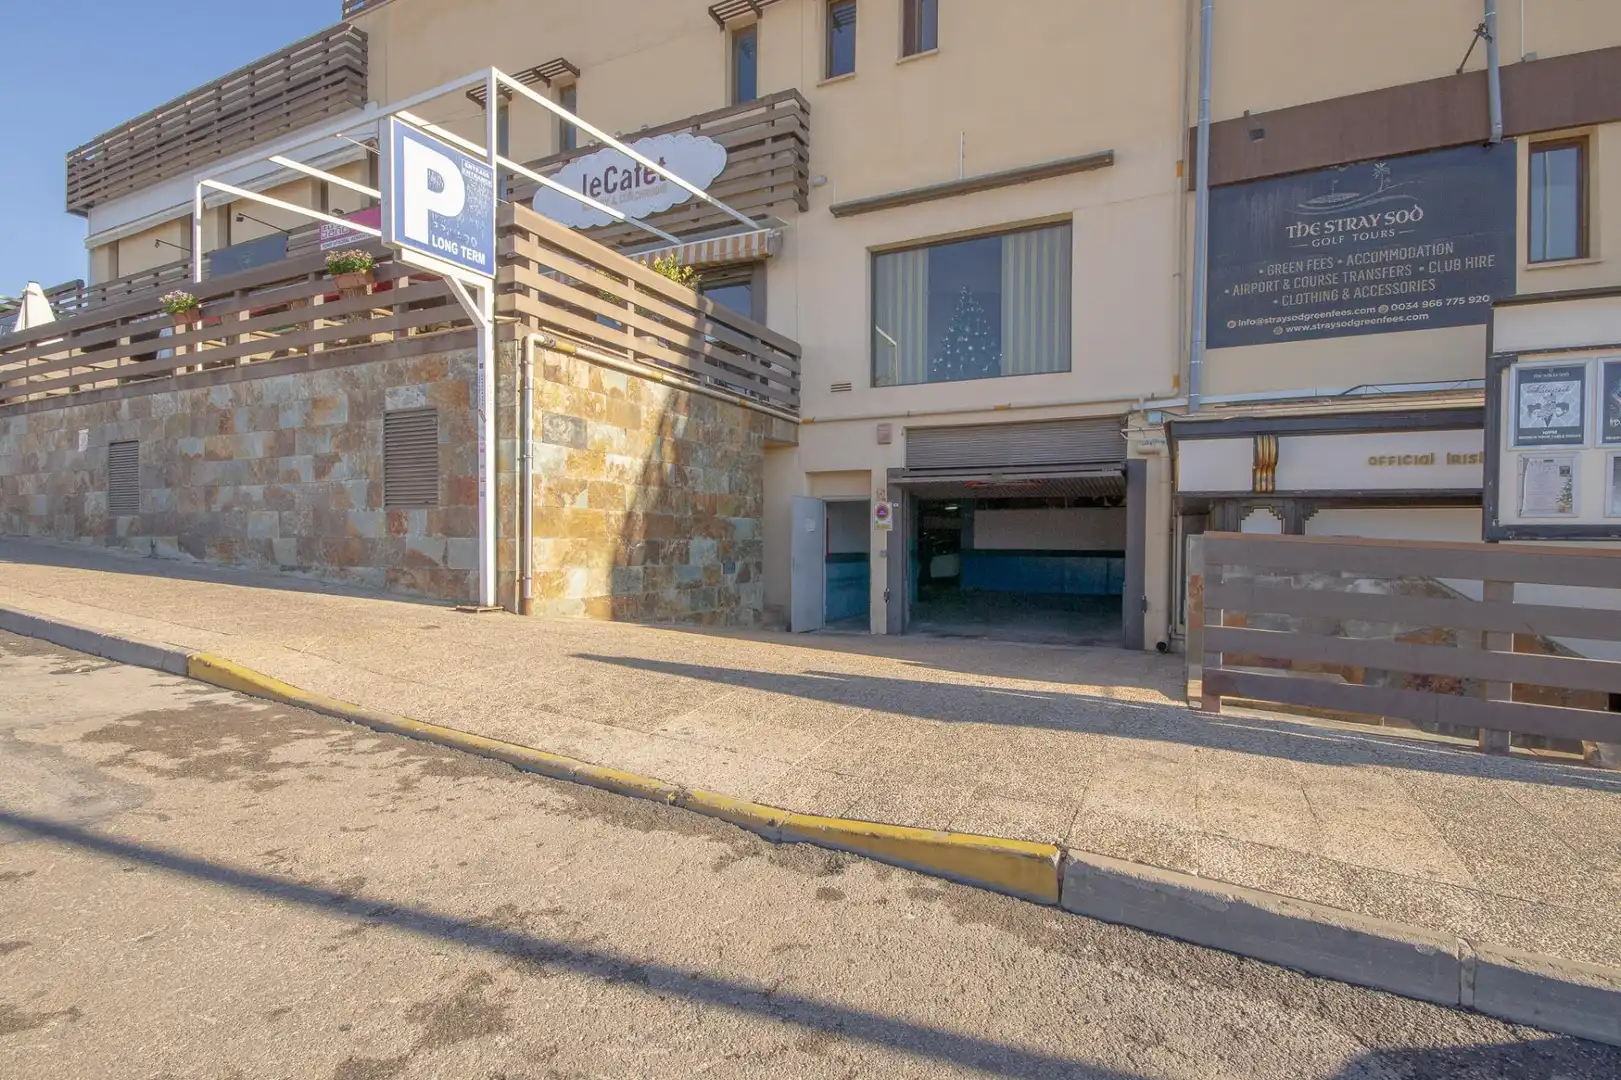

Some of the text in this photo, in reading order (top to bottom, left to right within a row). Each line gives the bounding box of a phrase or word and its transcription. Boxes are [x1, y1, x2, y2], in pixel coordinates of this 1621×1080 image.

[404, 136, 465, 245] P
[1311, 229, 1395, 248] GOLF TOURS
[1324, 213, 1381, 234] STRAY
[431, 234, 486, 265] LONG TERM
[1267, 242, 1454, 276] GREEN FEES ACCOMMODATION
[1232, 254, 1496, 296] AIRPORT & COURSE TRANSFERS CLUB HIRE
[1281, 278, 1436, 307] CLOTHING & ACCESSORIES
[1238, 294, 1490, 327] info@straysodgreenfees.com 0034 966 775 920
[1286, 312, 1430, 333] www.straysodgreenfees.com
